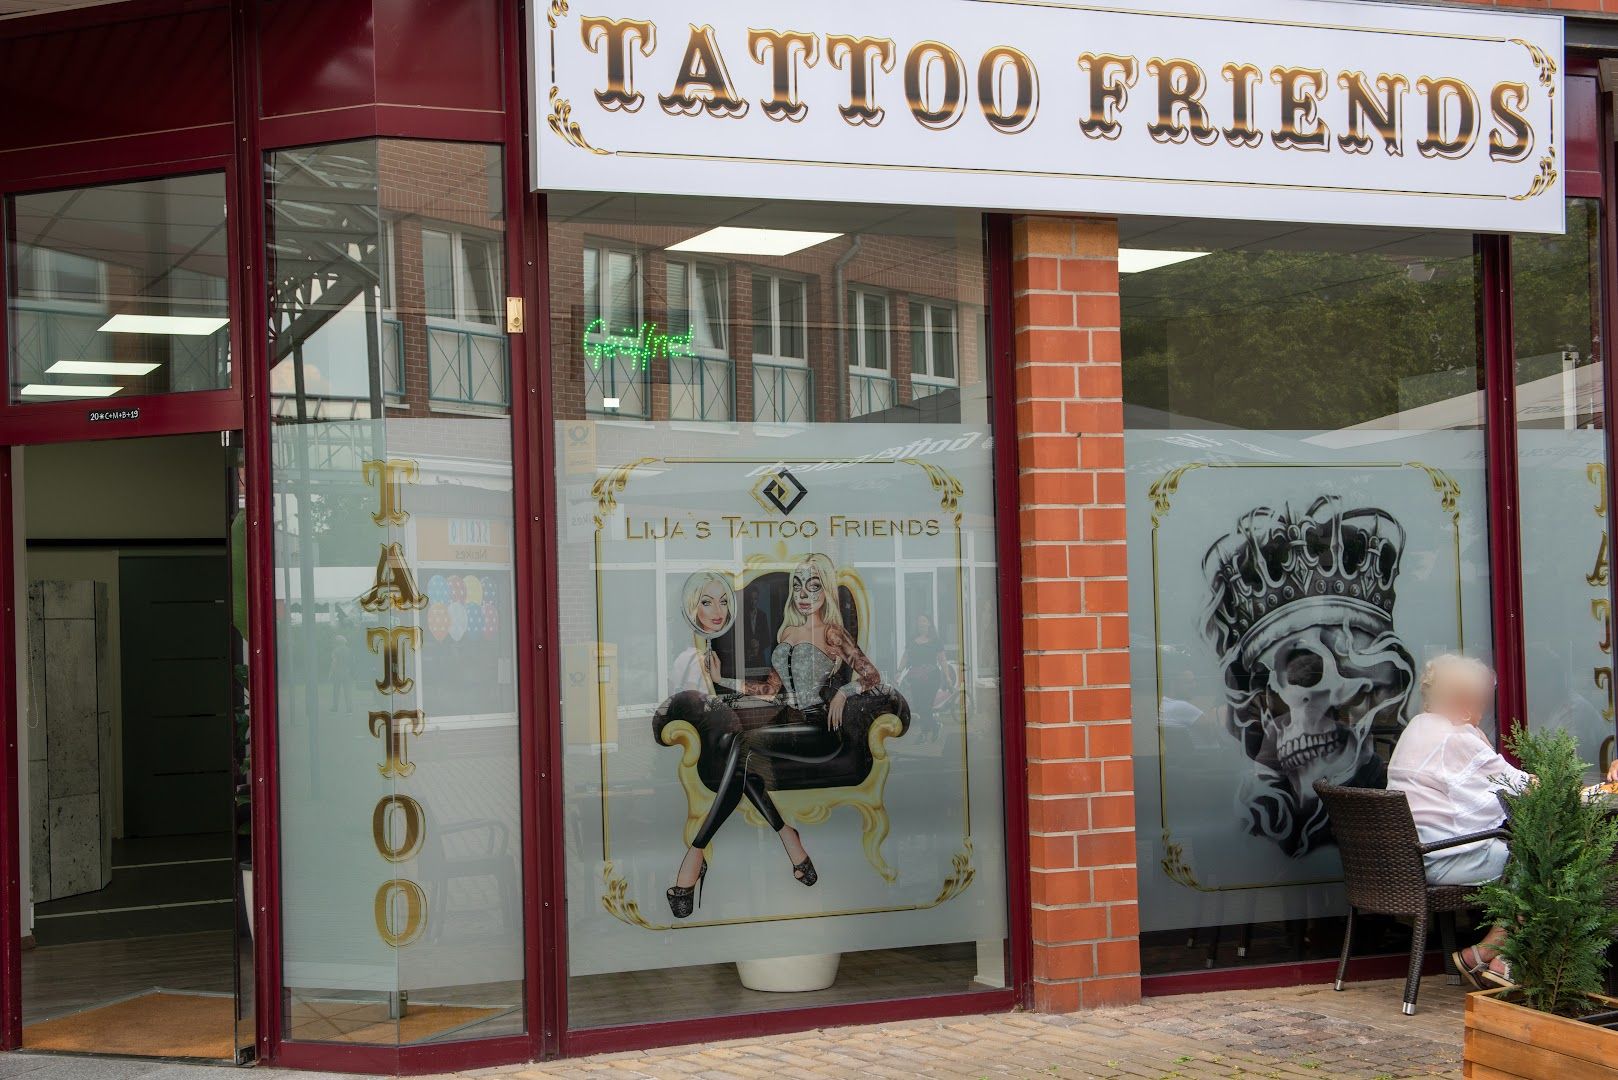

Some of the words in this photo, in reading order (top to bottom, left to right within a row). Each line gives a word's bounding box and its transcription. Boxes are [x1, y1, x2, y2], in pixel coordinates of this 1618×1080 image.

[580, 15, 1041, 135] TATTOO
[1076, 50, 1536, 164] FRIENDS
[583, 318, 696, 371] Geöffnet
[721, 516, 819, 539] TATTOO
[830, 515, 941, 537] FRIENDS
[360, 458, 429, 948] TATTOO
